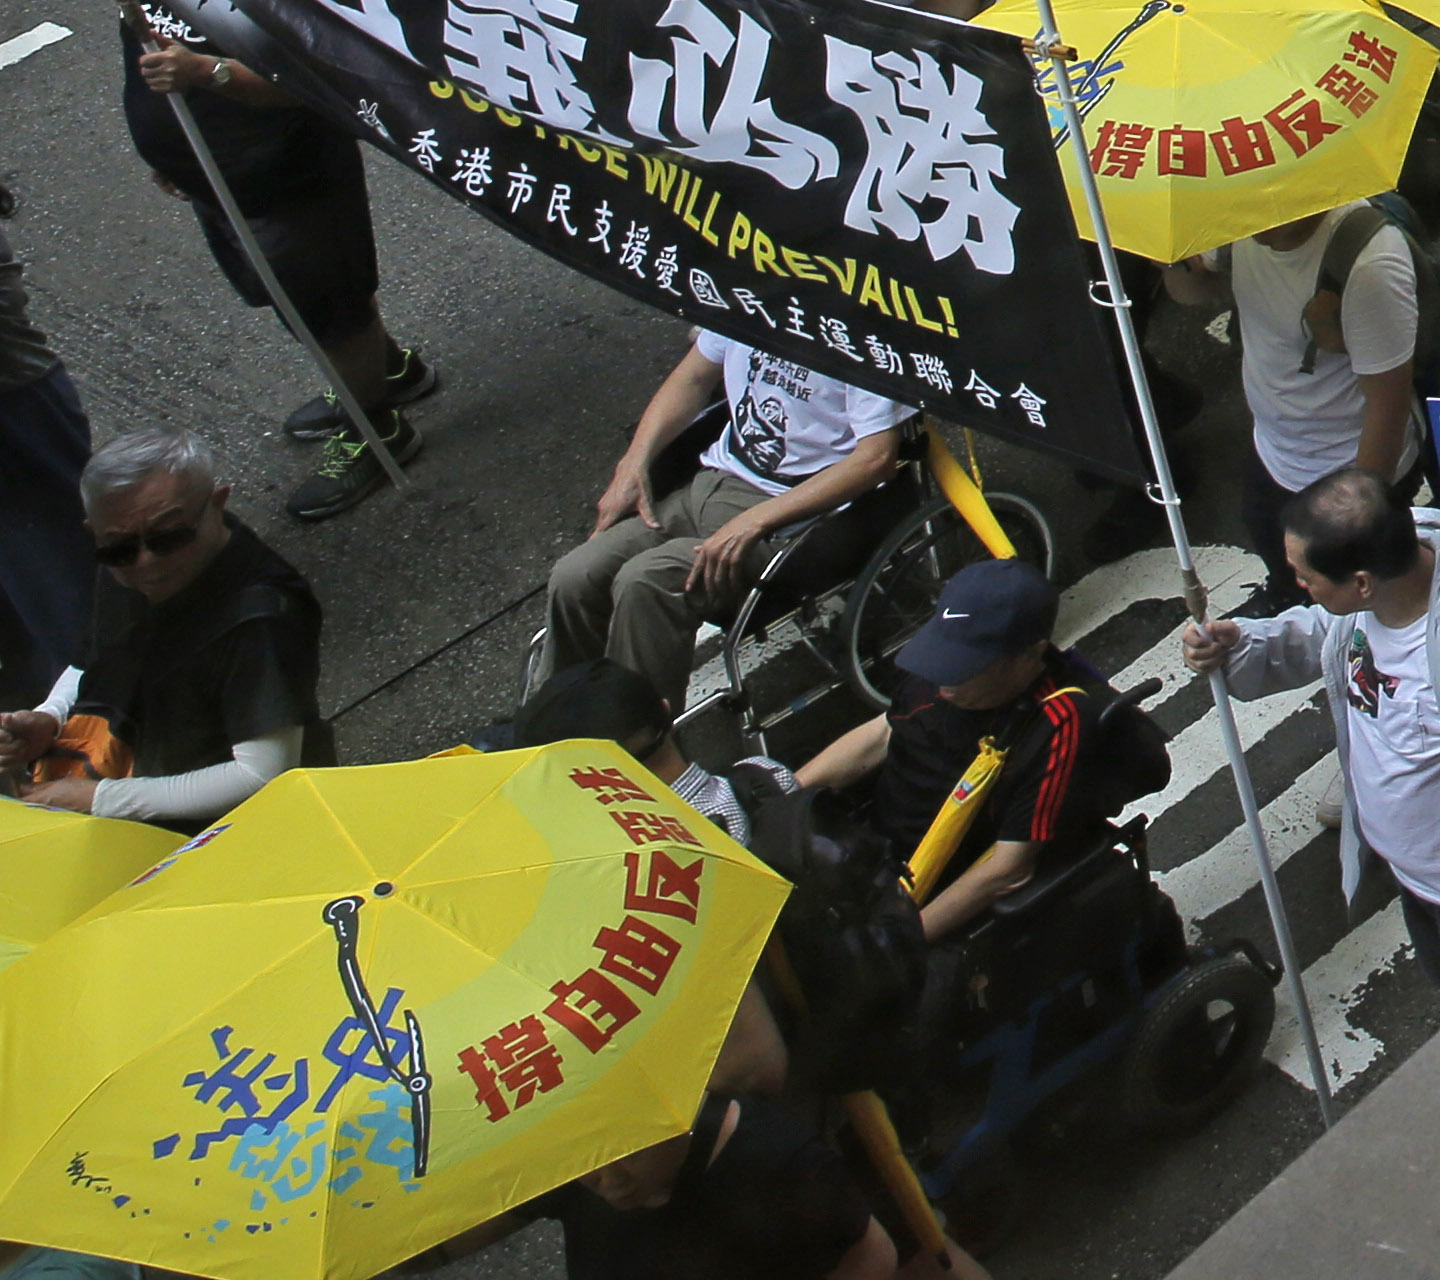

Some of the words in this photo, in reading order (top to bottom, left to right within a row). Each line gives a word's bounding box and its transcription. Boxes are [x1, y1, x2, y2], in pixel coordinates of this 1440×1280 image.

[1089, 30, 1398, 180] 撐自由反惡法
[407, 129, 1048, 428] 香港市民支援愛國民主運動聯合會
[637, 152, 722, 249] WILL
[726, 214, 960, 339] PREVAIL!
[459, 764, 705, 1124] 撐自由反惡法
